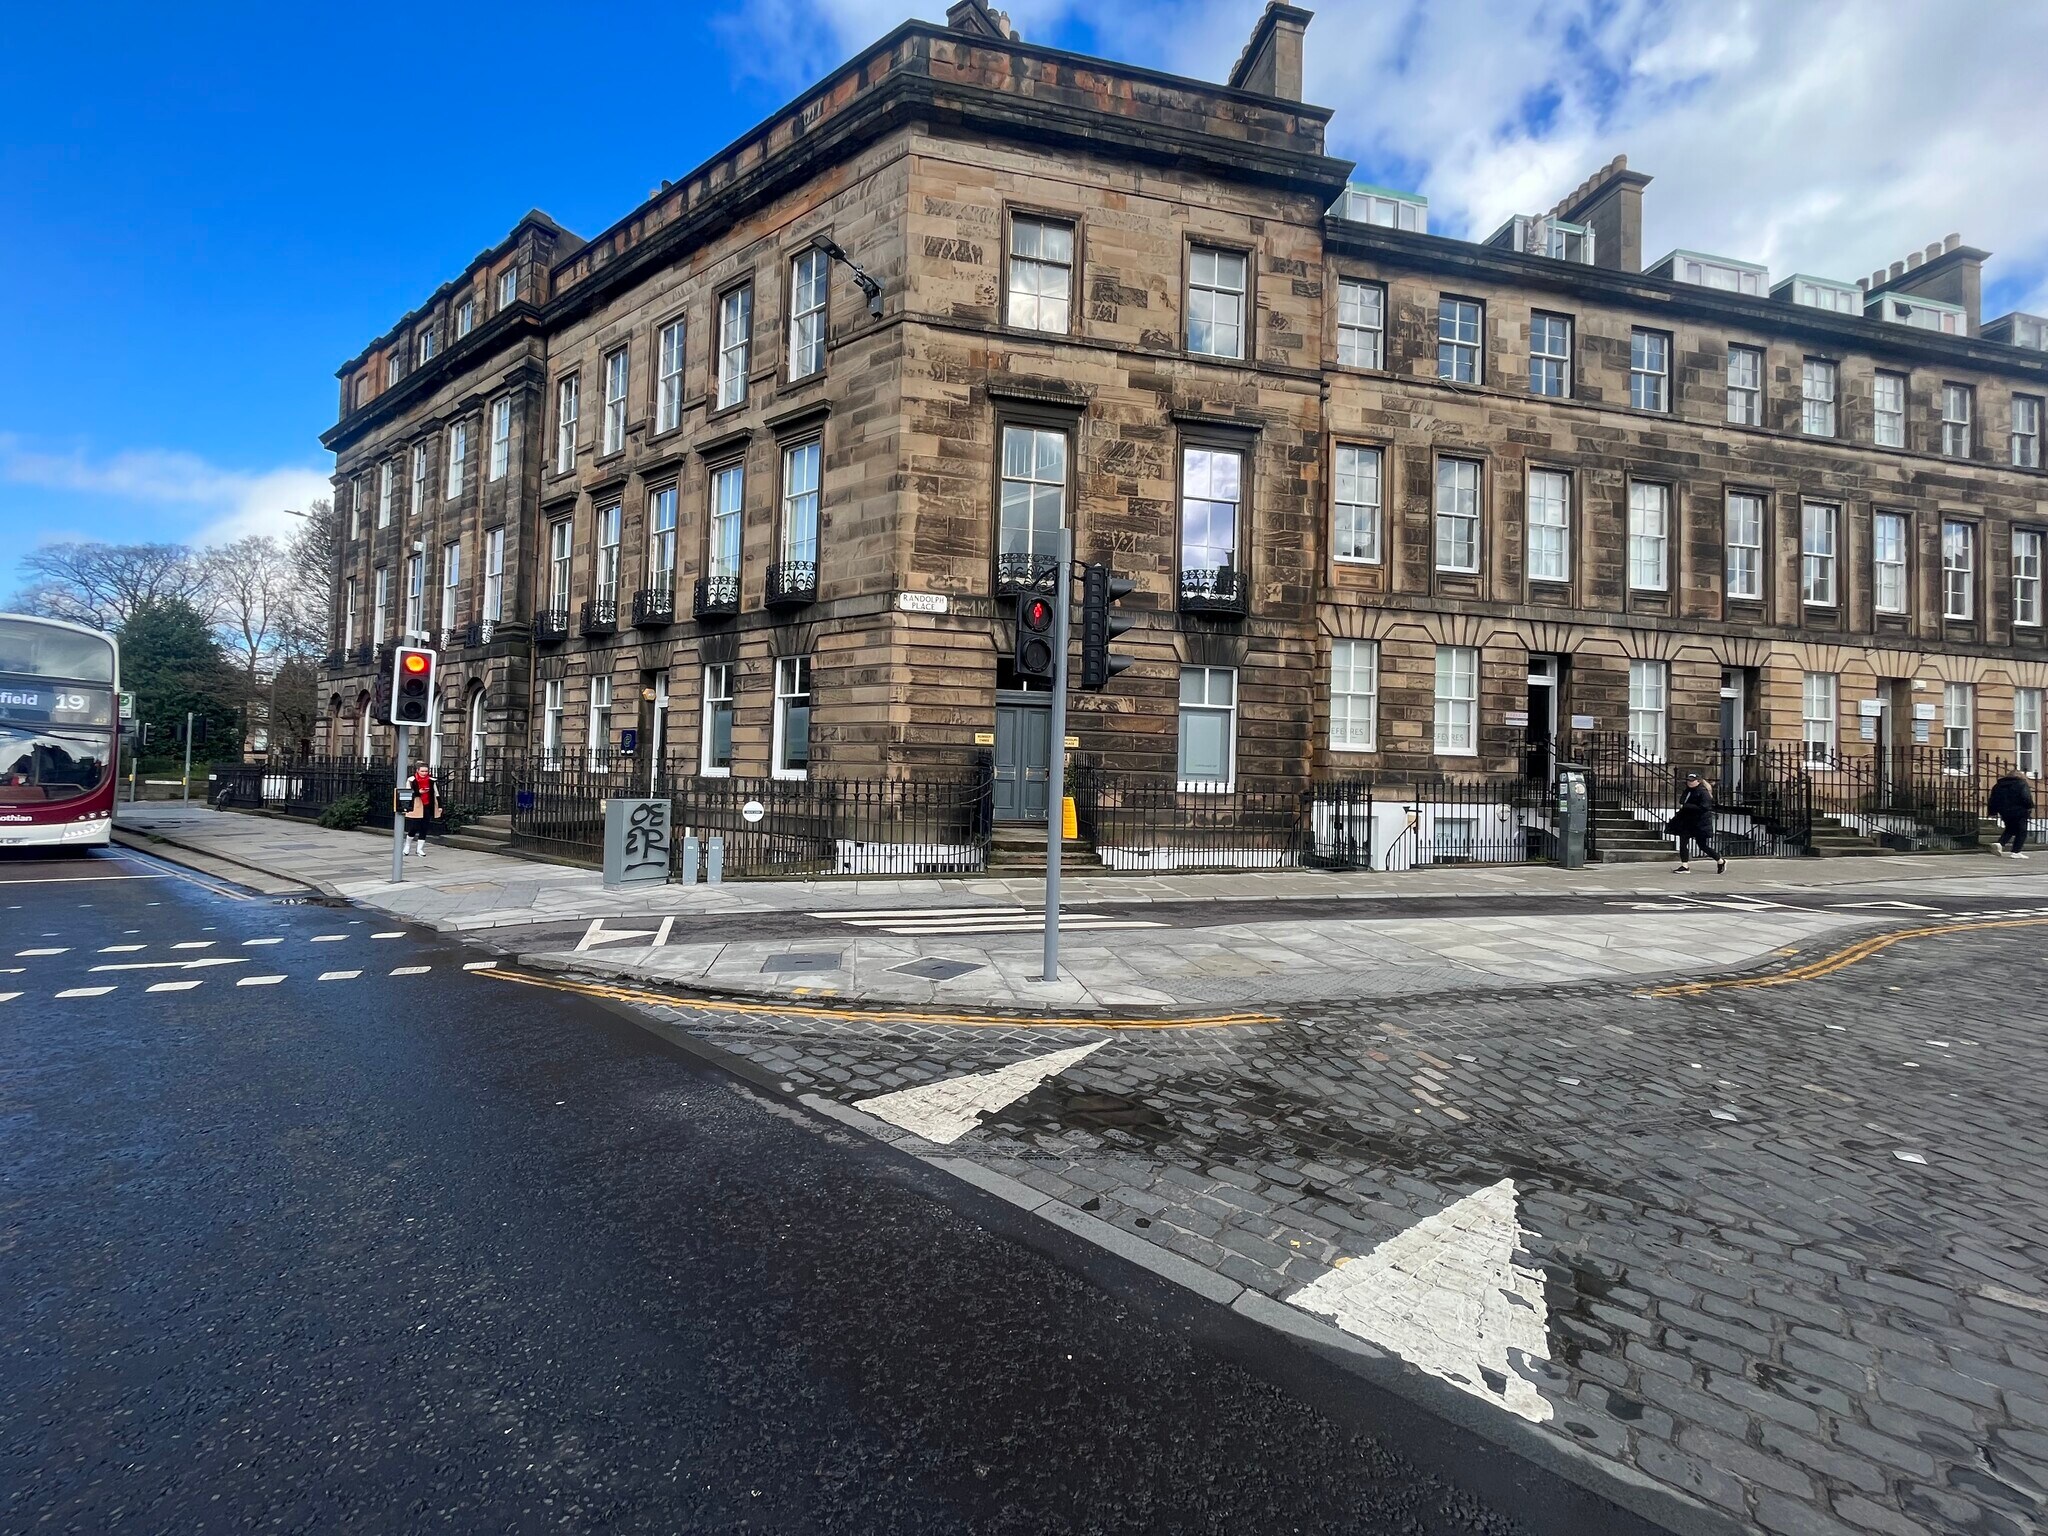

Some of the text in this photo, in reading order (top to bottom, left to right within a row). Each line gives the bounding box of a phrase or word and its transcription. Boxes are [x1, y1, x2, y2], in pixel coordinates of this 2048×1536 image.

[903, 594, 944, 603] RANDOLPH
[911, 602, 935, 610] PLACE
[55, 694, 85, 710] 19
